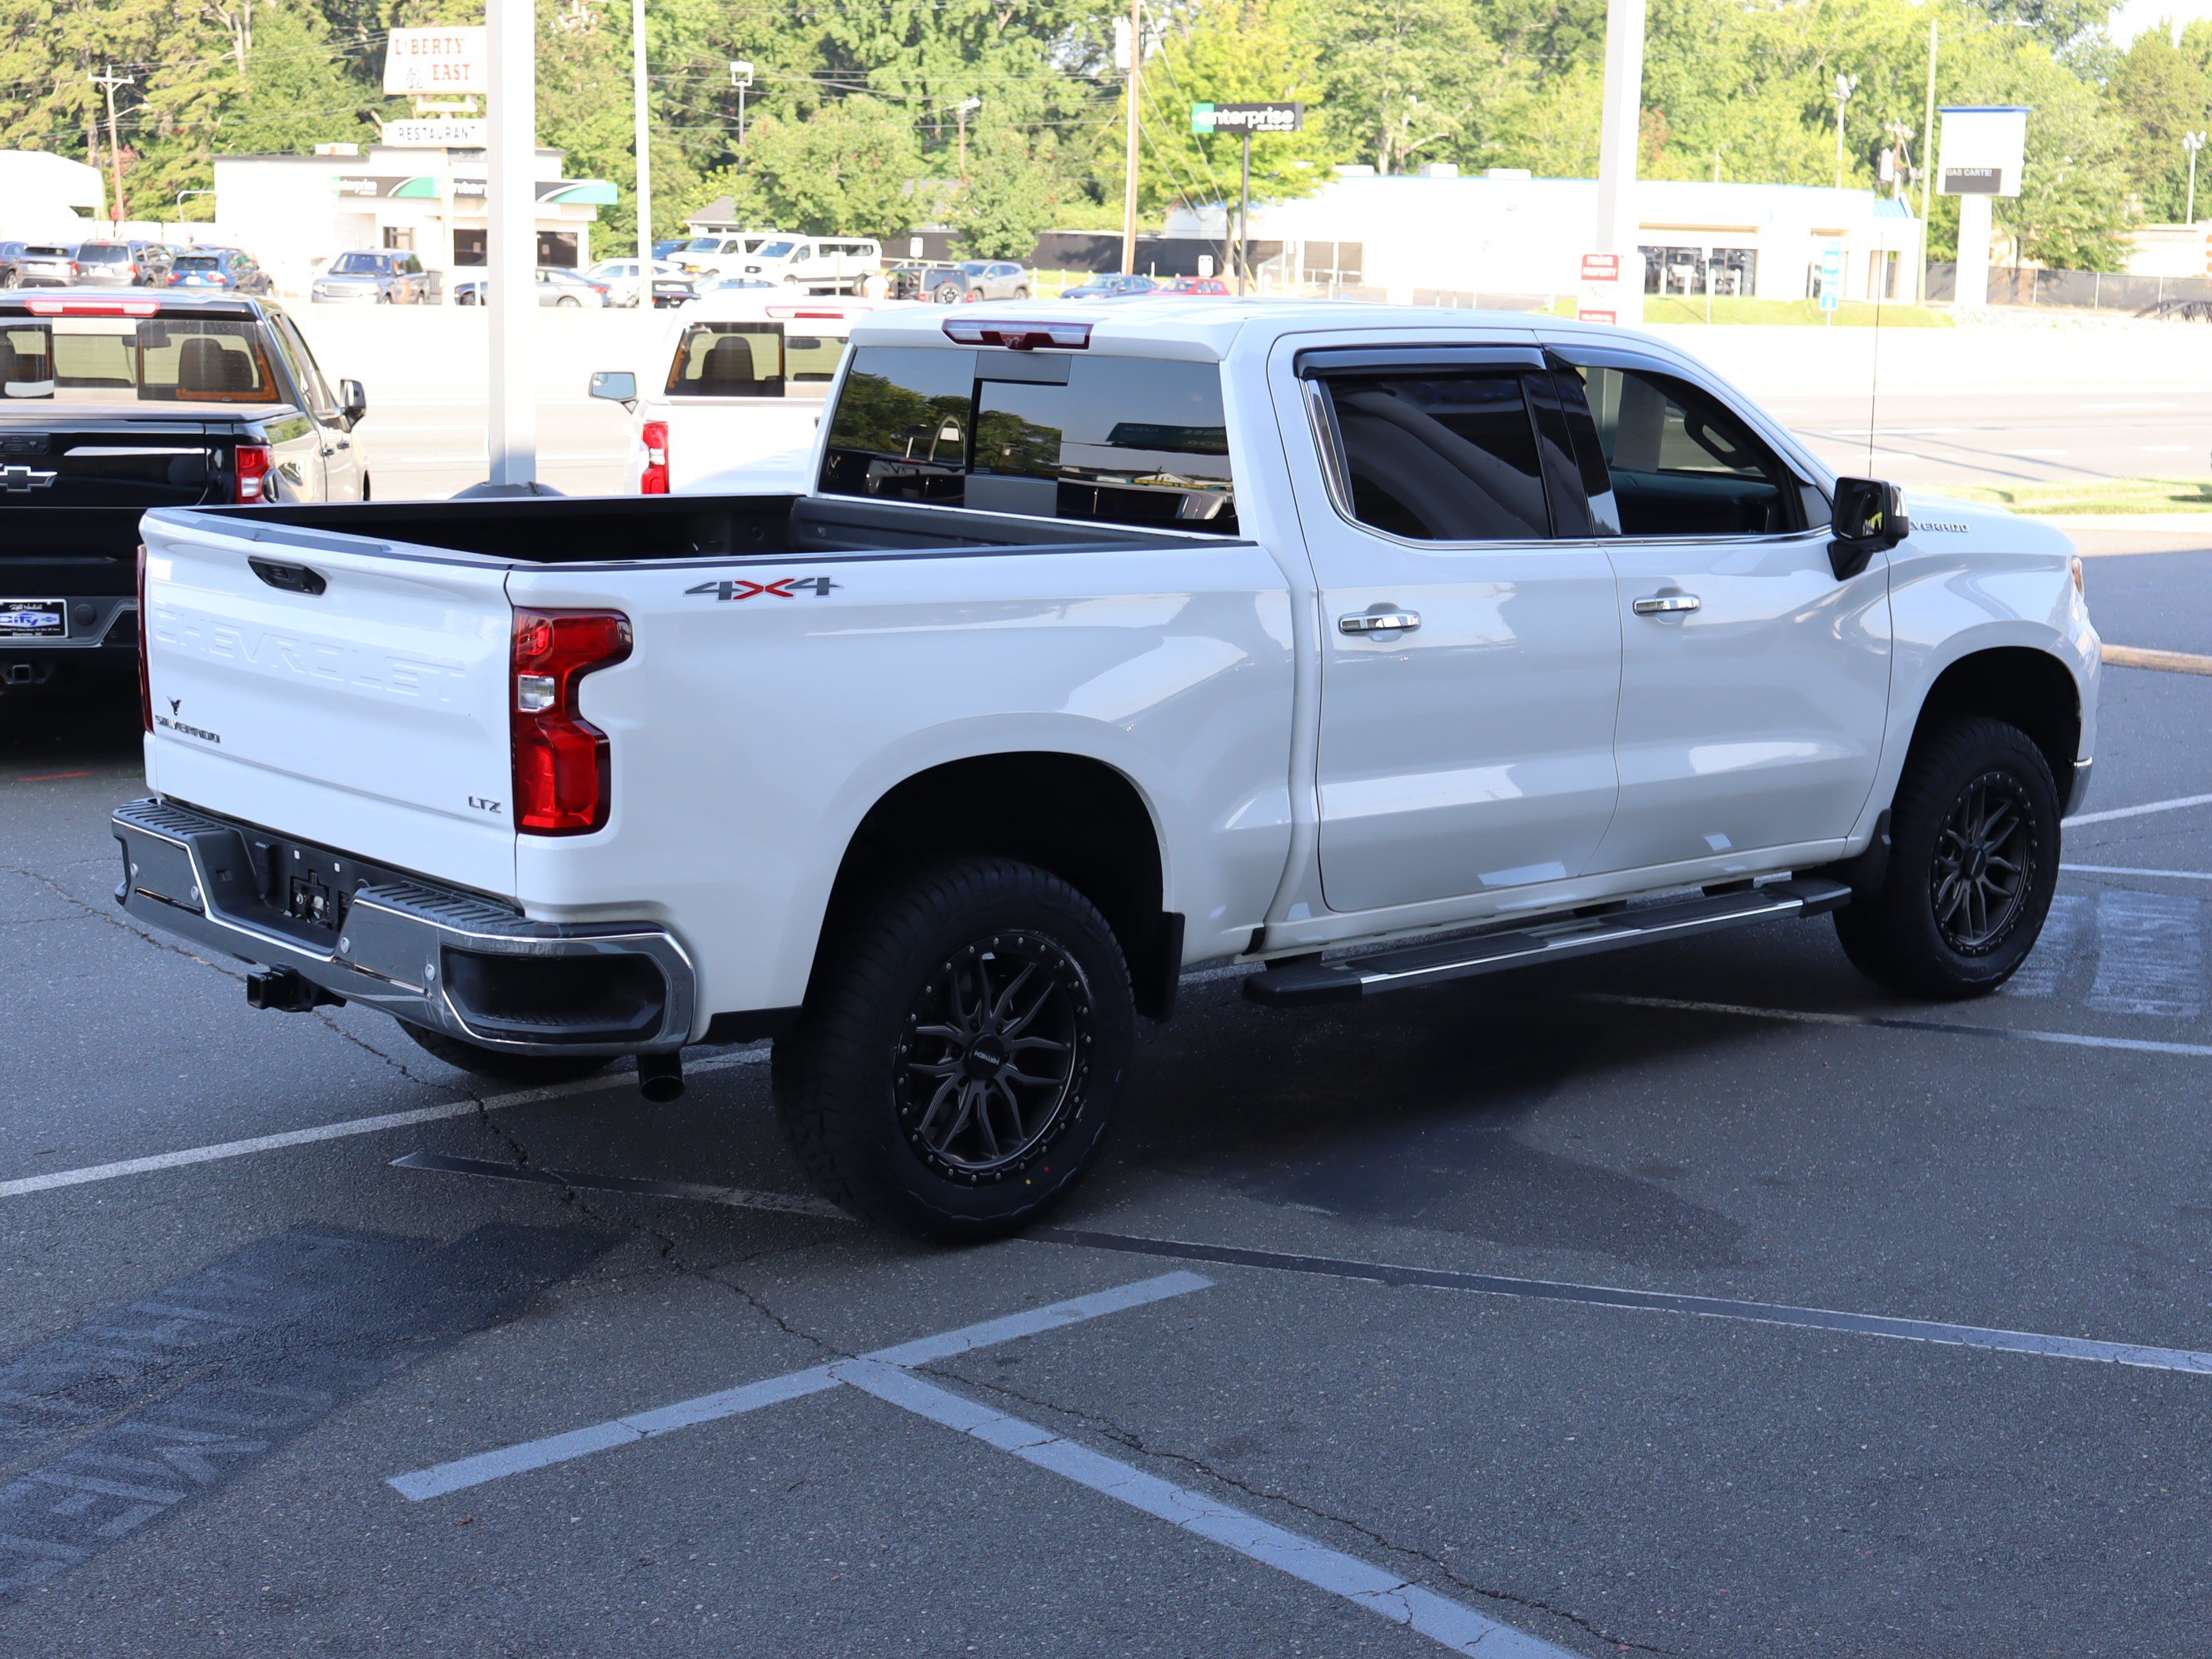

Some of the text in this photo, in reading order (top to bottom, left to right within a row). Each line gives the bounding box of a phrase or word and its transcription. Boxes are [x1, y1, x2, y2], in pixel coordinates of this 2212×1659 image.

[396, 38, 463, 55] LIBERTY
[433, 64, 470, 81] EAST
[1192, 106, 1295, 128] enterprise
[399, 126, 476, 141] RESTAURANT
[1947, 168, 1962, 177] GAS
[1909, 521, 1969, 533] VERADO
[684, 575, 843, 601] 4X4
[154, 607, 467, 704] CHEVROLET
[155, 715, 221, 744] SILVERADO
[468, 795, 501, 815] LTZ
